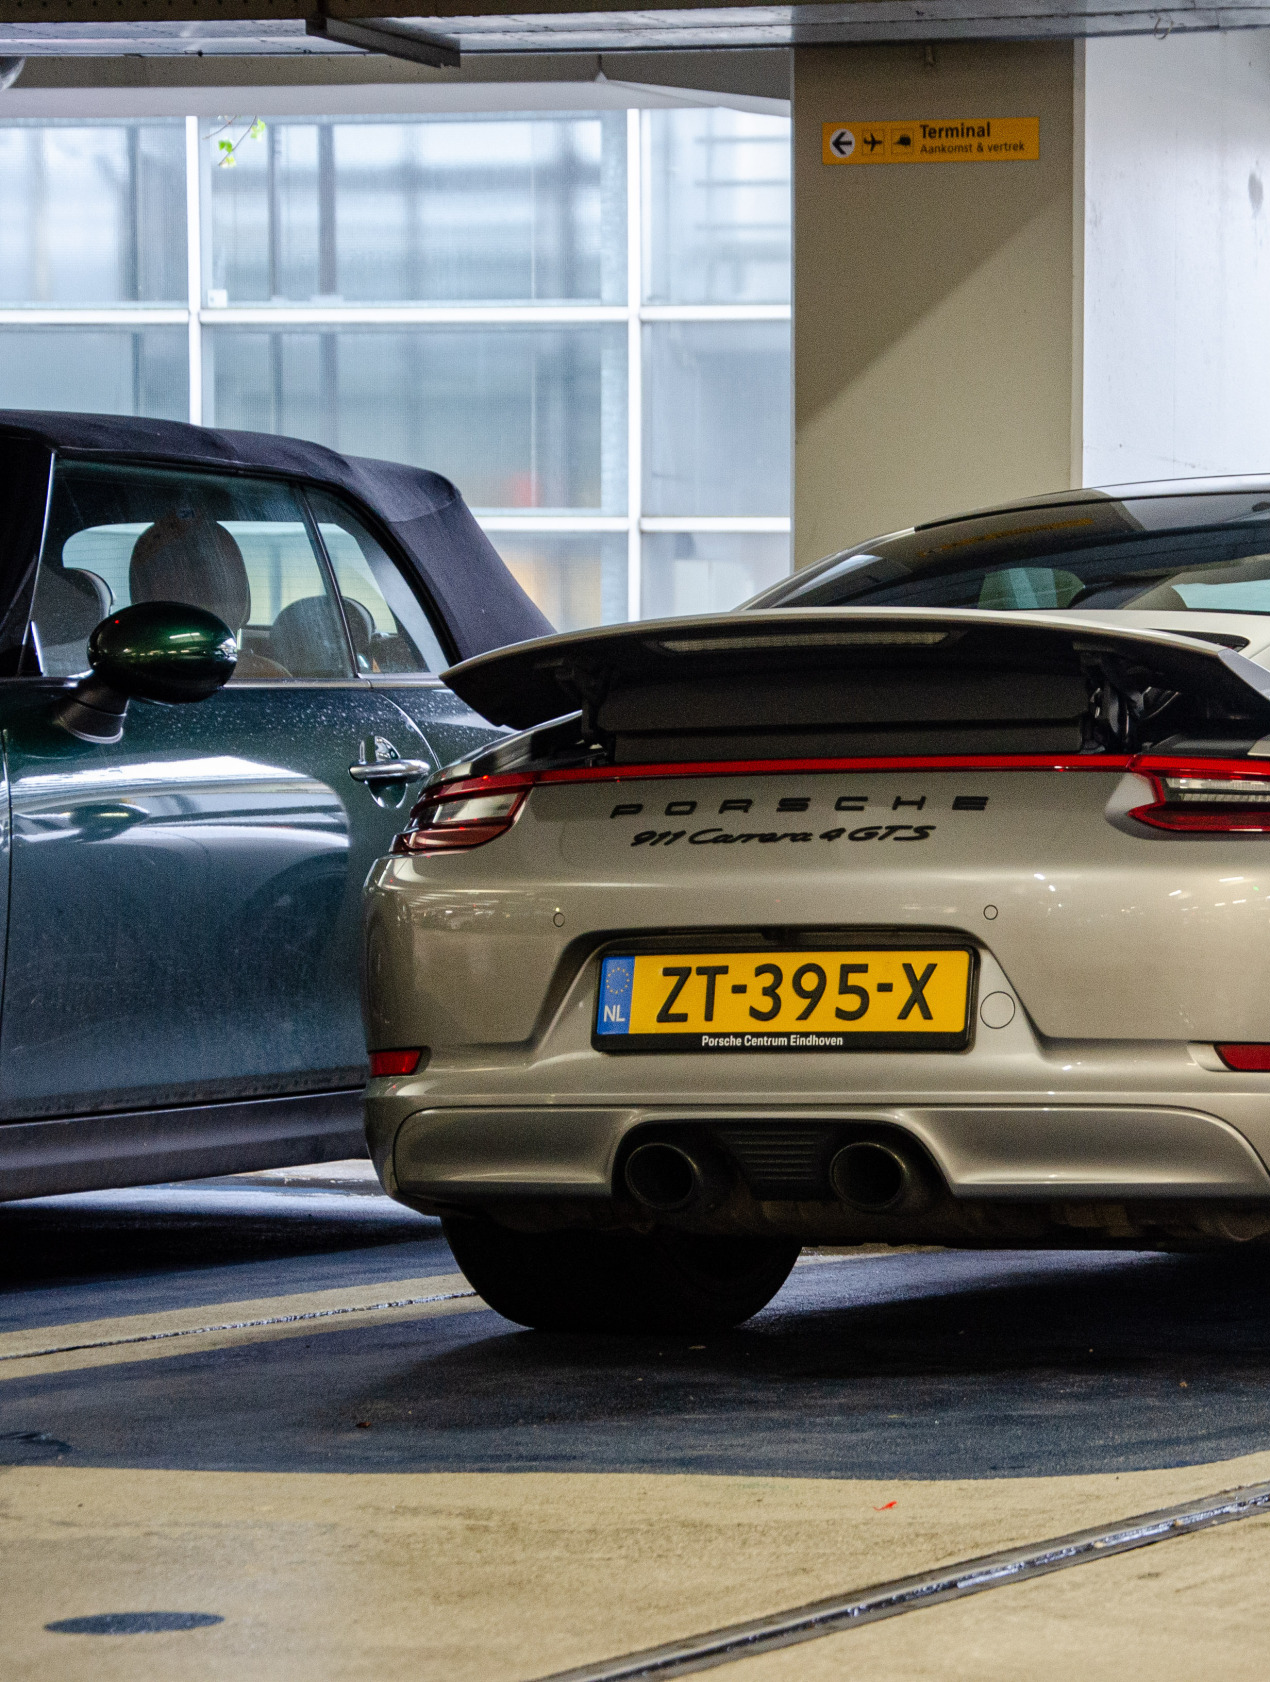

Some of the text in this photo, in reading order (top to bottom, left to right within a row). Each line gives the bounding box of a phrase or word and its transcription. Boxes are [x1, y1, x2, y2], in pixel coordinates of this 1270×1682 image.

[919, 121, 991, 139] Terminal
[920, 141, 1025, 154] Aankomst & vertrek
[609, 796, 989, 819] PORSCHE
[630, 830, 686, 846] 911
[688, 828, 813, 845] Carrera
[656, 963, 938, 1023] ZT-395-X
[603, 1004, 626, 1022] NL
[701, 1034, 844, 1047] Porsche Centrum Eindhoven
